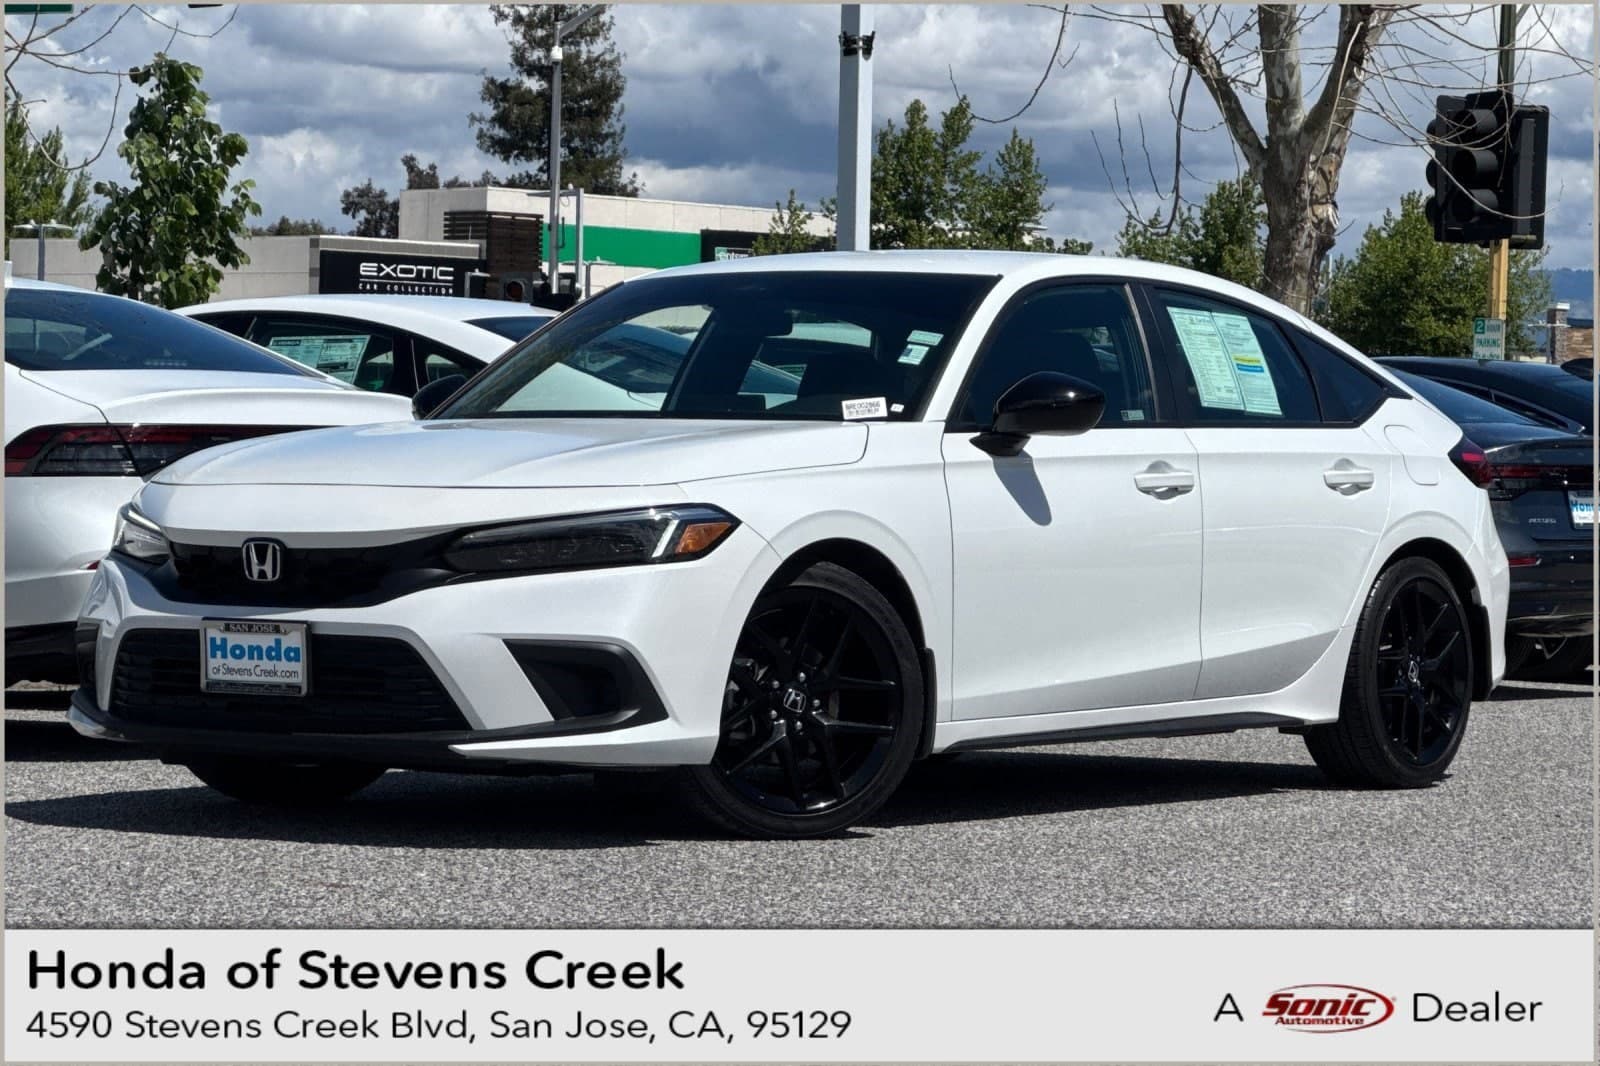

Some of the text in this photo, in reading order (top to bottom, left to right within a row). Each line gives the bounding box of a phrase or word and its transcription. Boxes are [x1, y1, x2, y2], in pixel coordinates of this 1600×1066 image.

[360, 262, 455, 280] EXOTIC
[1476, 320, 1484, 333] 2
[1571, 501, 1594, 512] Hon
[229, 623, 277, 633] SAN JOSE
[209, 636, 301, 663] Honda
[212, 663, 299, 679] of Stevens Creek.com
